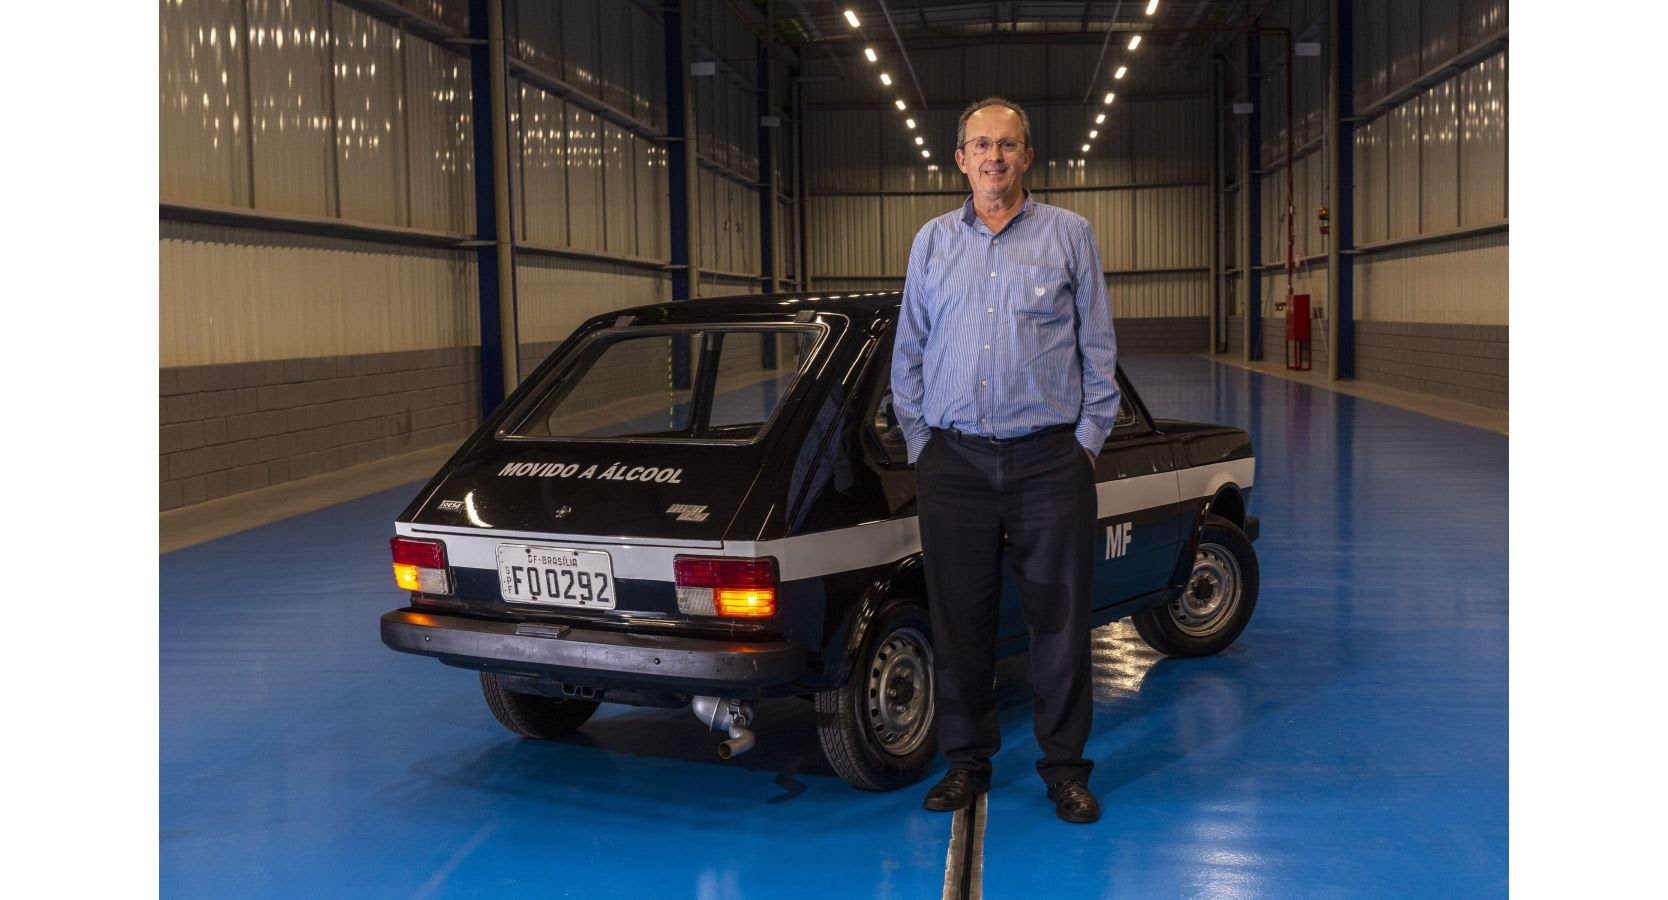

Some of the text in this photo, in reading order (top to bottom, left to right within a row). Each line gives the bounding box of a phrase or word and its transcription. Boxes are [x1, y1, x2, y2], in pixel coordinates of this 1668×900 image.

[497, 461, 683, 484] MOVIDO A ÁLCOOL
[1105, 521, 1133, 561] MF
